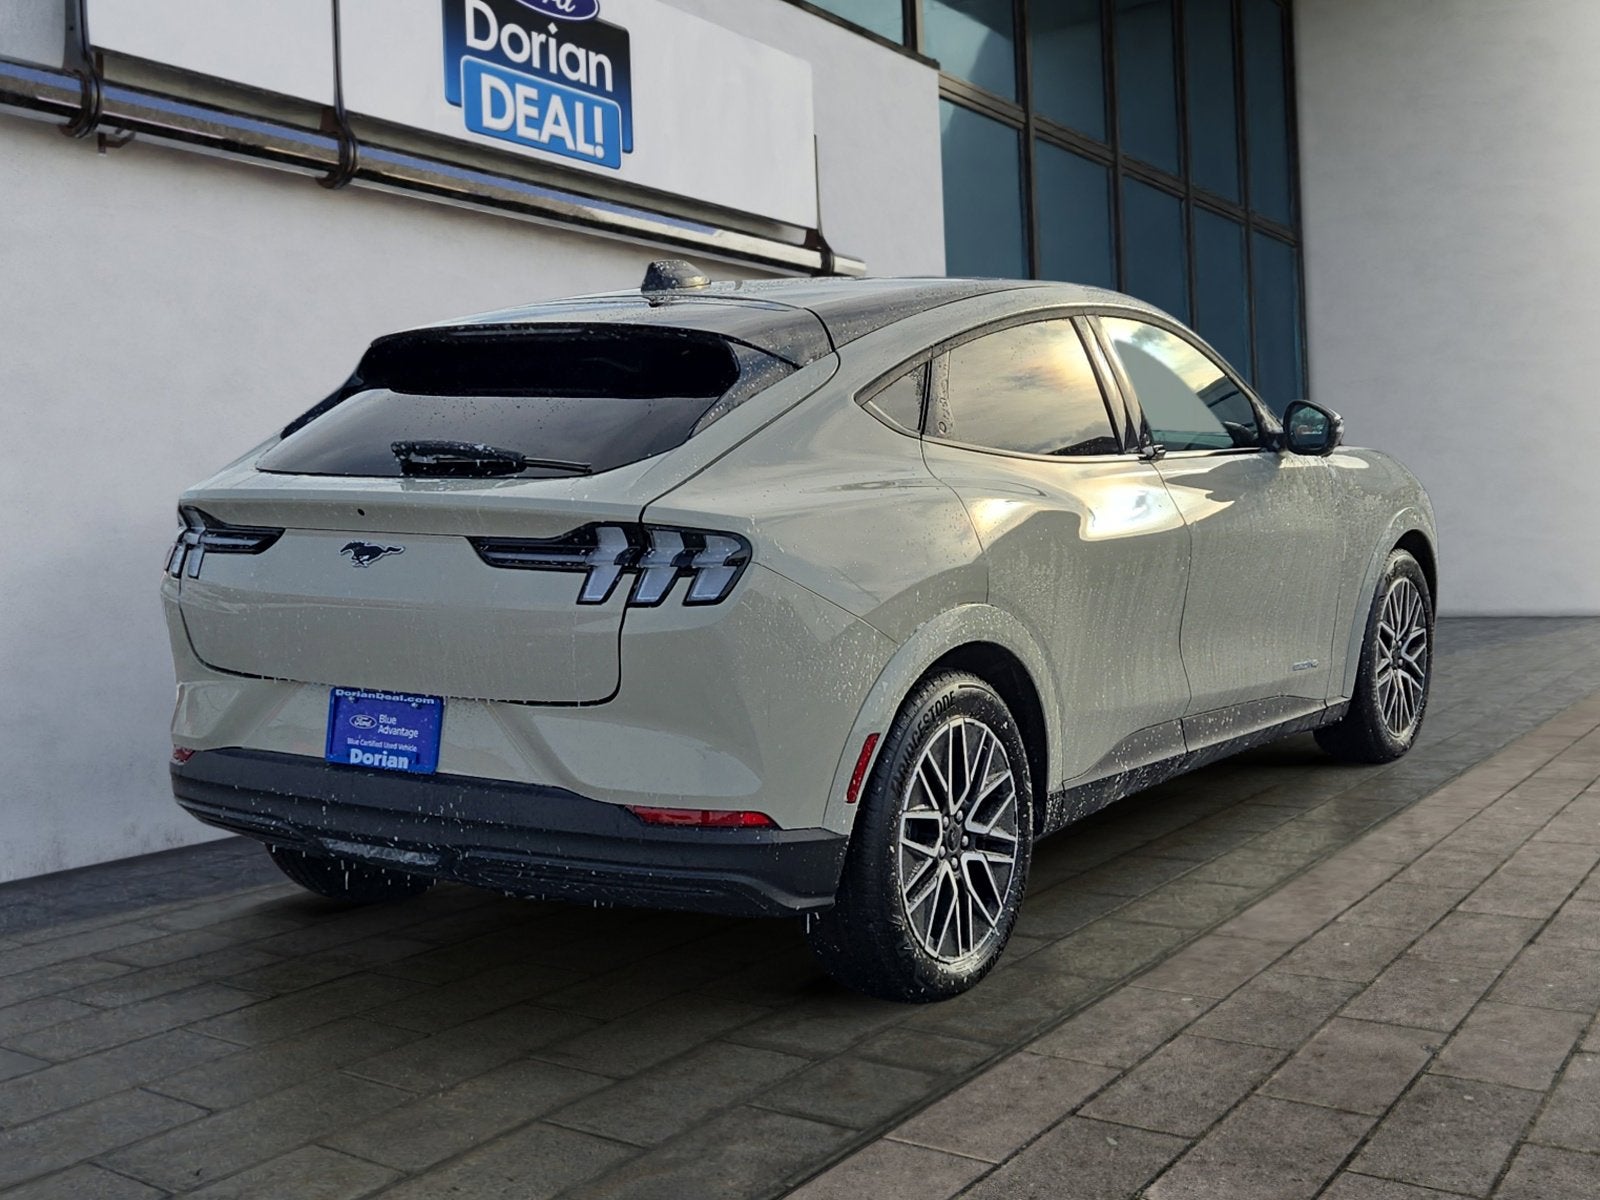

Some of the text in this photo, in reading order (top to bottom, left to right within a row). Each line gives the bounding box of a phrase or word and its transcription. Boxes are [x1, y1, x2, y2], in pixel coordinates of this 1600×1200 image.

[465, 0, 613, 92] Dorian
[480, 72, 605, 159] DEAL!
[335, 689, 435, 705] DorianDeal.com
[378, 714, 397, 725] Blue
[377, 725, 419, 739] Advantage
[350, 748, 409, 769] Dorian
